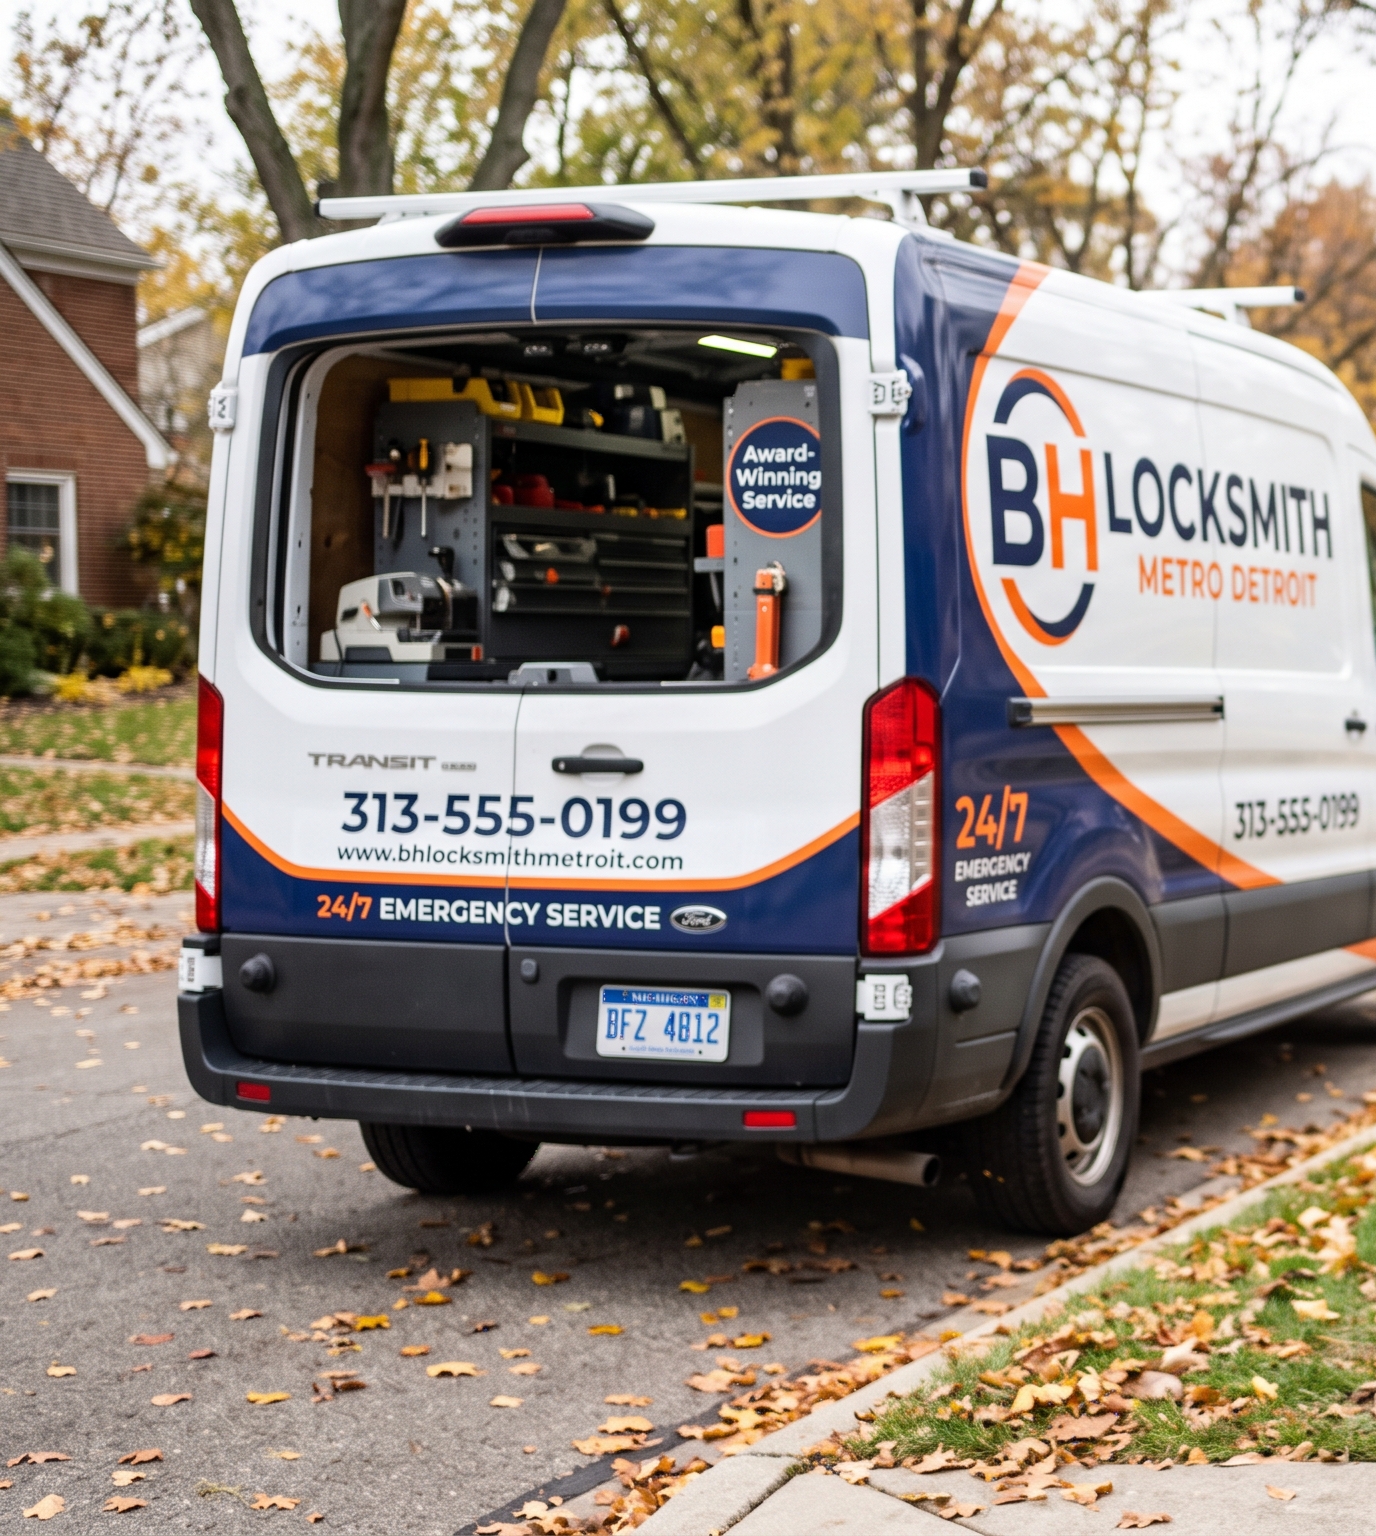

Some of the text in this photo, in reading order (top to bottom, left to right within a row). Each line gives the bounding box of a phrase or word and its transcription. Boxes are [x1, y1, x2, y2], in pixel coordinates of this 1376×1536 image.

[742, 442, 816, 464] Award-
[735, 465, 822, 490] Winning
[742, 488, 817, 510] Service
[986, 433, 1099, 572] BH
[1103, 451, 1334, 560] LOCKSMITH
[1138, 554, 1318, 608] METRO DETROIT
[307, 752, 437, 771] TRANSIT
[341, 791, 687, 840] 313-555-0199
[955, 784, 1029, 851] 24/7
[1233, 793, 1360, 840] 313-555-0199
[337, 843, 684, 871] www.bhlocksmithmetroit.com
[954, 851, 1032, 883] EMERGENCY
[315, 891, 662, 930] 24/7 EMERGENCY SERVICE
[965, 879, 1018, 908] SERVICE
[605, 1007, 648, 1041] BFZ
